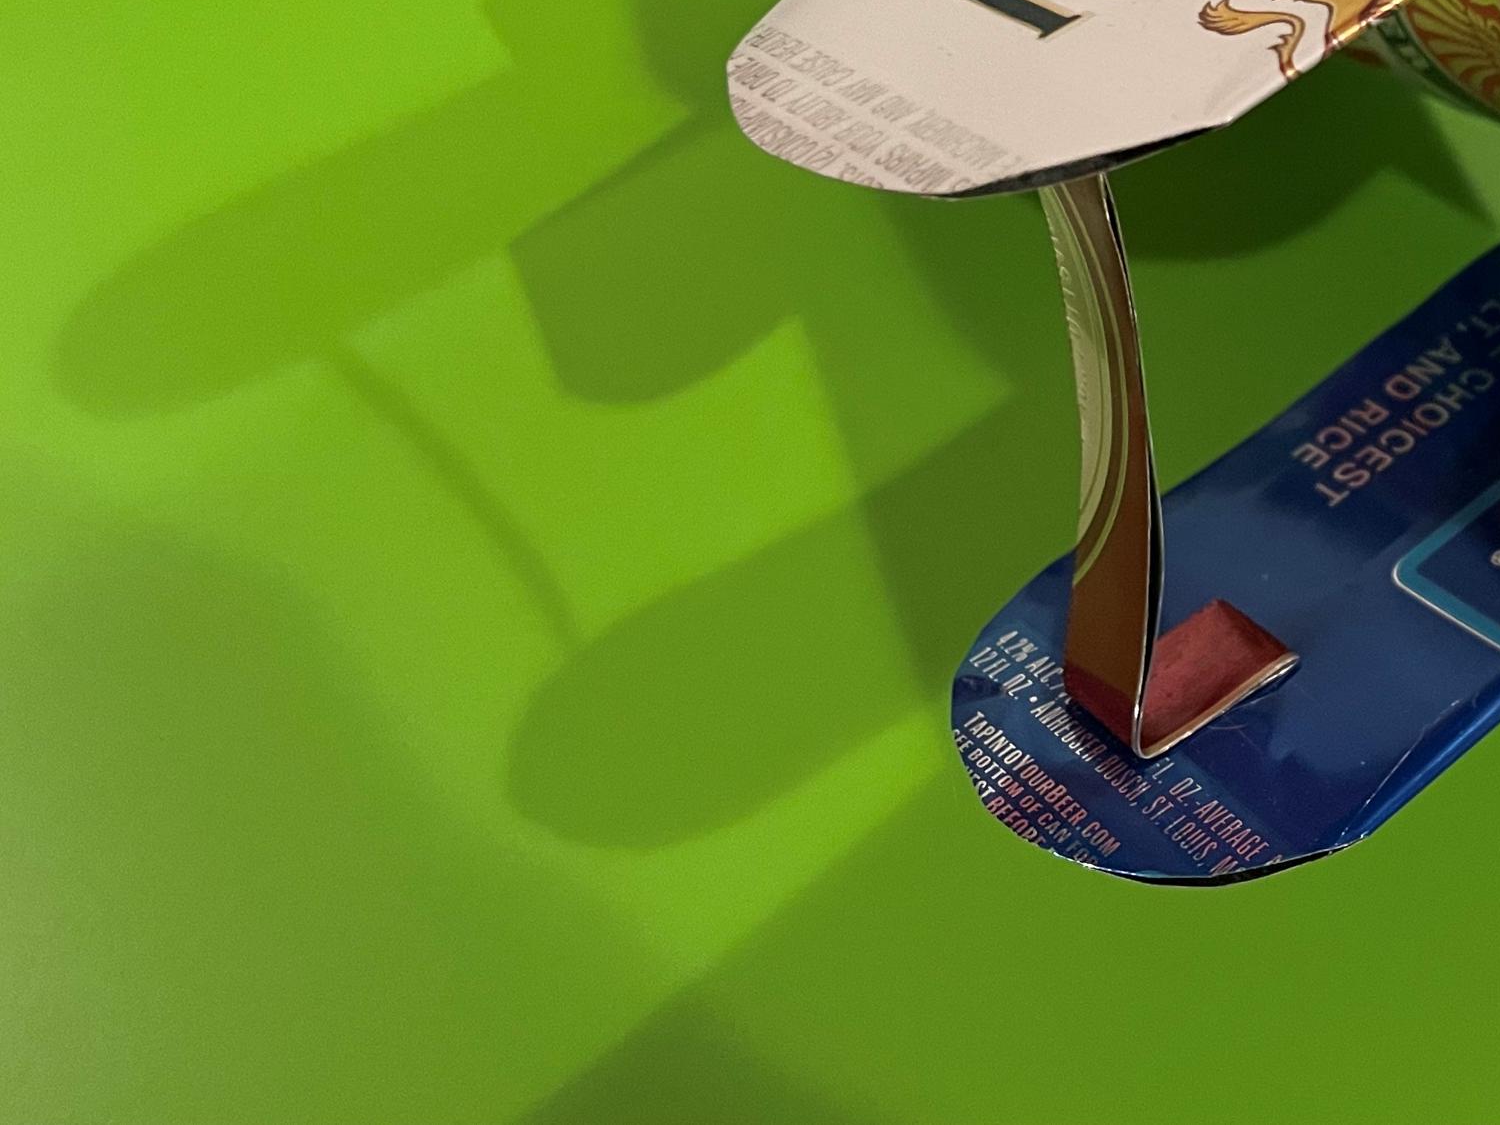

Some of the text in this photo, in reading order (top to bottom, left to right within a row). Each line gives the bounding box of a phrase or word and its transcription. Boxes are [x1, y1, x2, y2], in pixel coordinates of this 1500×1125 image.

[1384, 335, 1464, 401] AND
[1290, 397, 1390, 471] RICE
[1314, 367, 1497, 508] CHOICEST
[996, 630, 1039, 663] 4.2%
[967, 747, 1025, 798] BOTTOM
[1019, 794, 1044, 814] OF
[1037, 812, 1073, 844] CAN
[1142, 794, 1175, 825] ST.
